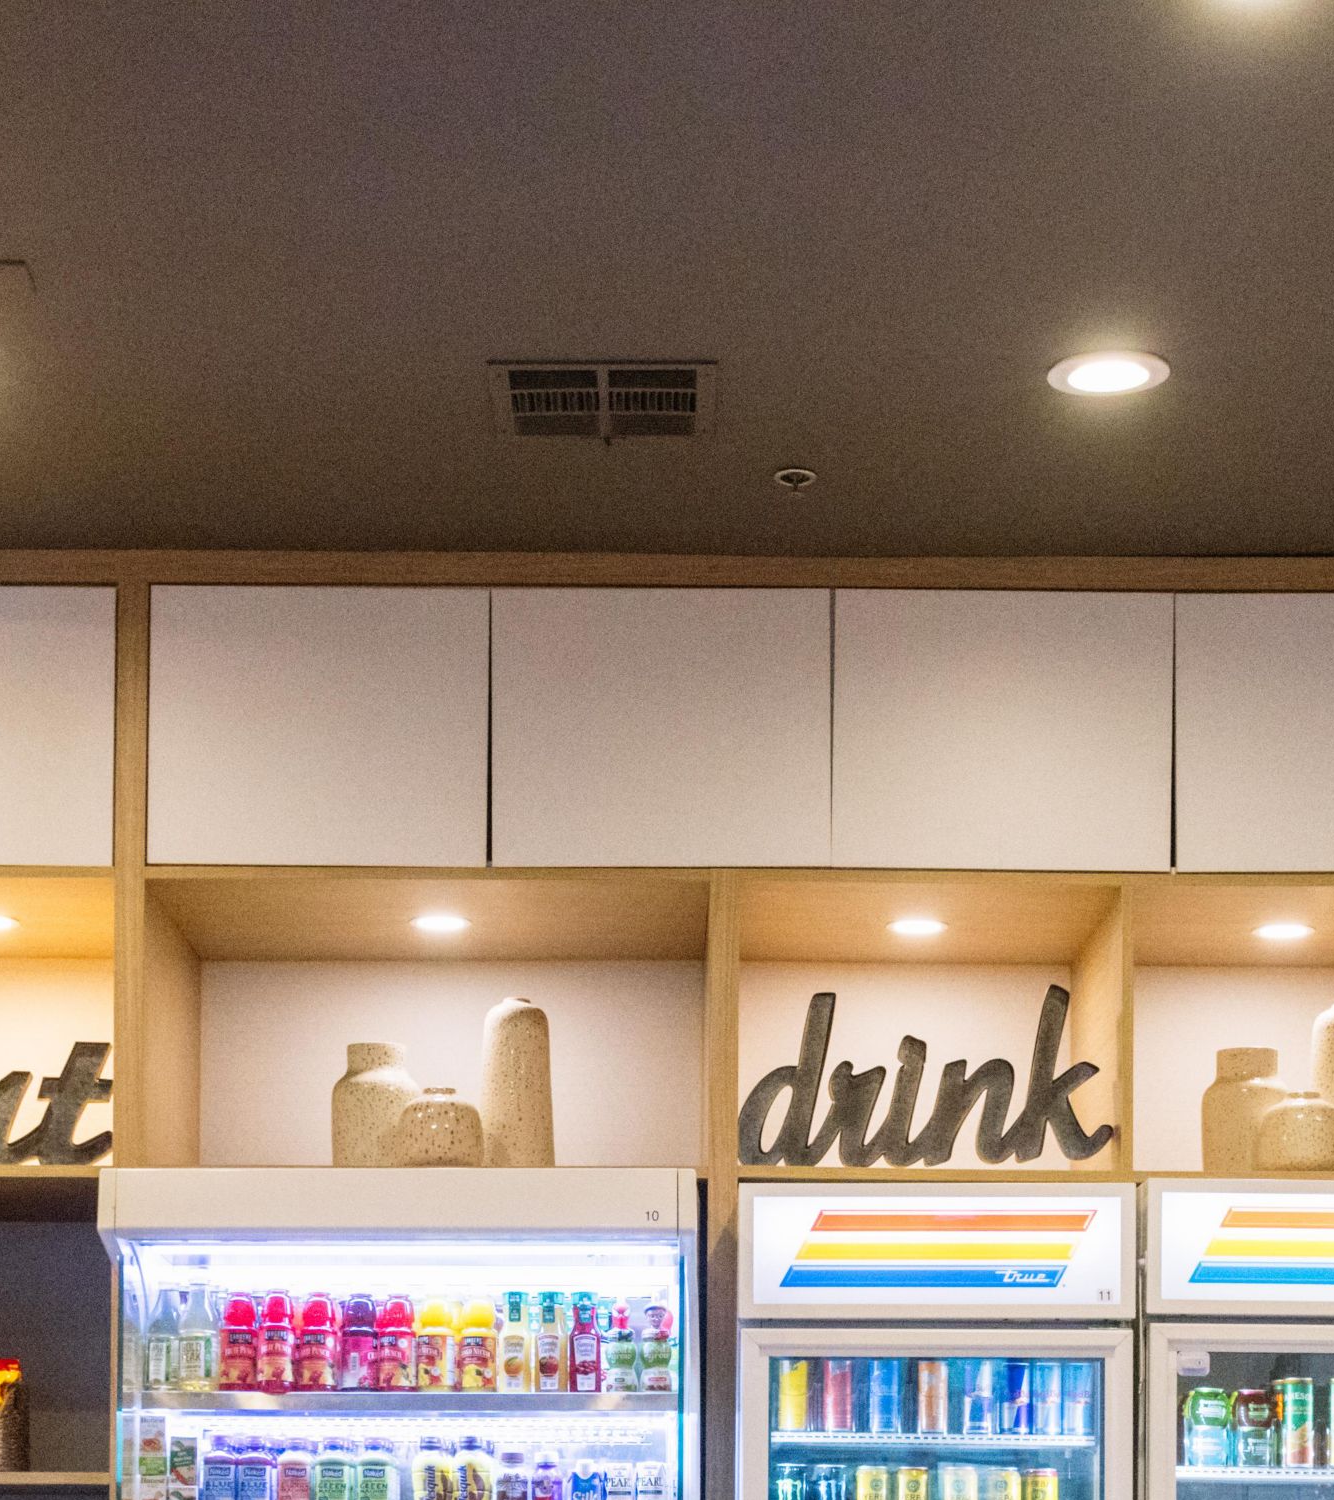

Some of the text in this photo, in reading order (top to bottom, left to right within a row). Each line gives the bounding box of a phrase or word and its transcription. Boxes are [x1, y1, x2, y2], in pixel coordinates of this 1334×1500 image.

[738, 983, 1114, 1168] drink
[645, 1210, 660, 1222] 10
[1097, 1290, 1112, 1301] 11
